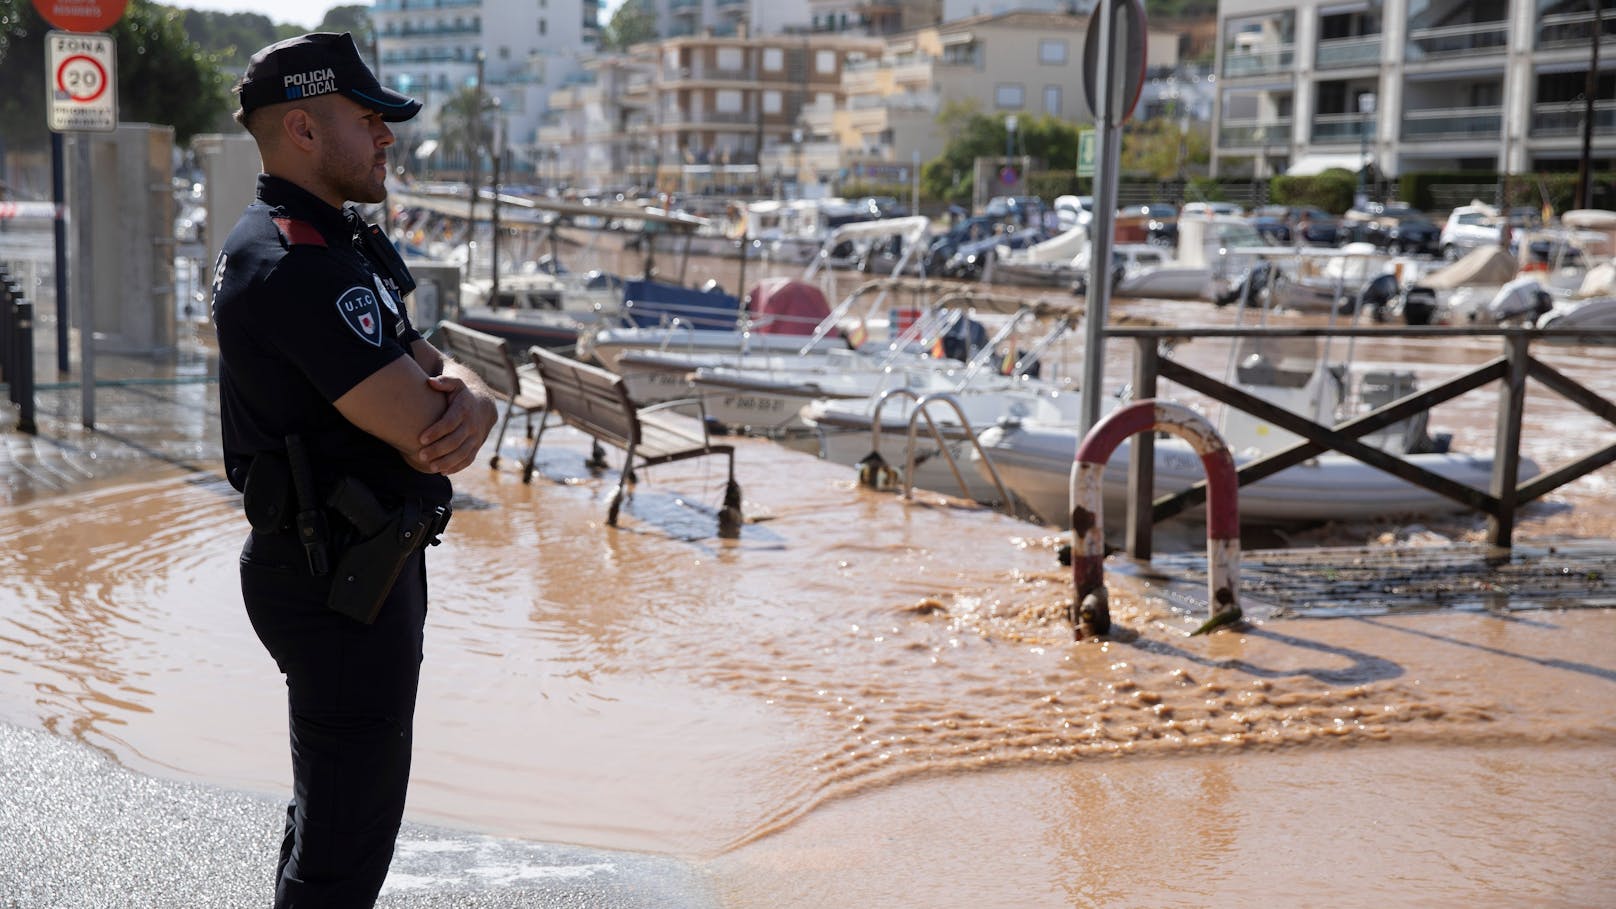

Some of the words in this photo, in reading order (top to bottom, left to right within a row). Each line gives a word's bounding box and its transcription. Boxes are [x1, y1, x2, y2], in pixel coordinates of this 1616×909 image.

[57, 40, 106, 53] ZONA
[68, 70, 97, 88] 20
[284, 67, 335, 87] POLICIA
[302, 79, 338, 97] LOCAL
